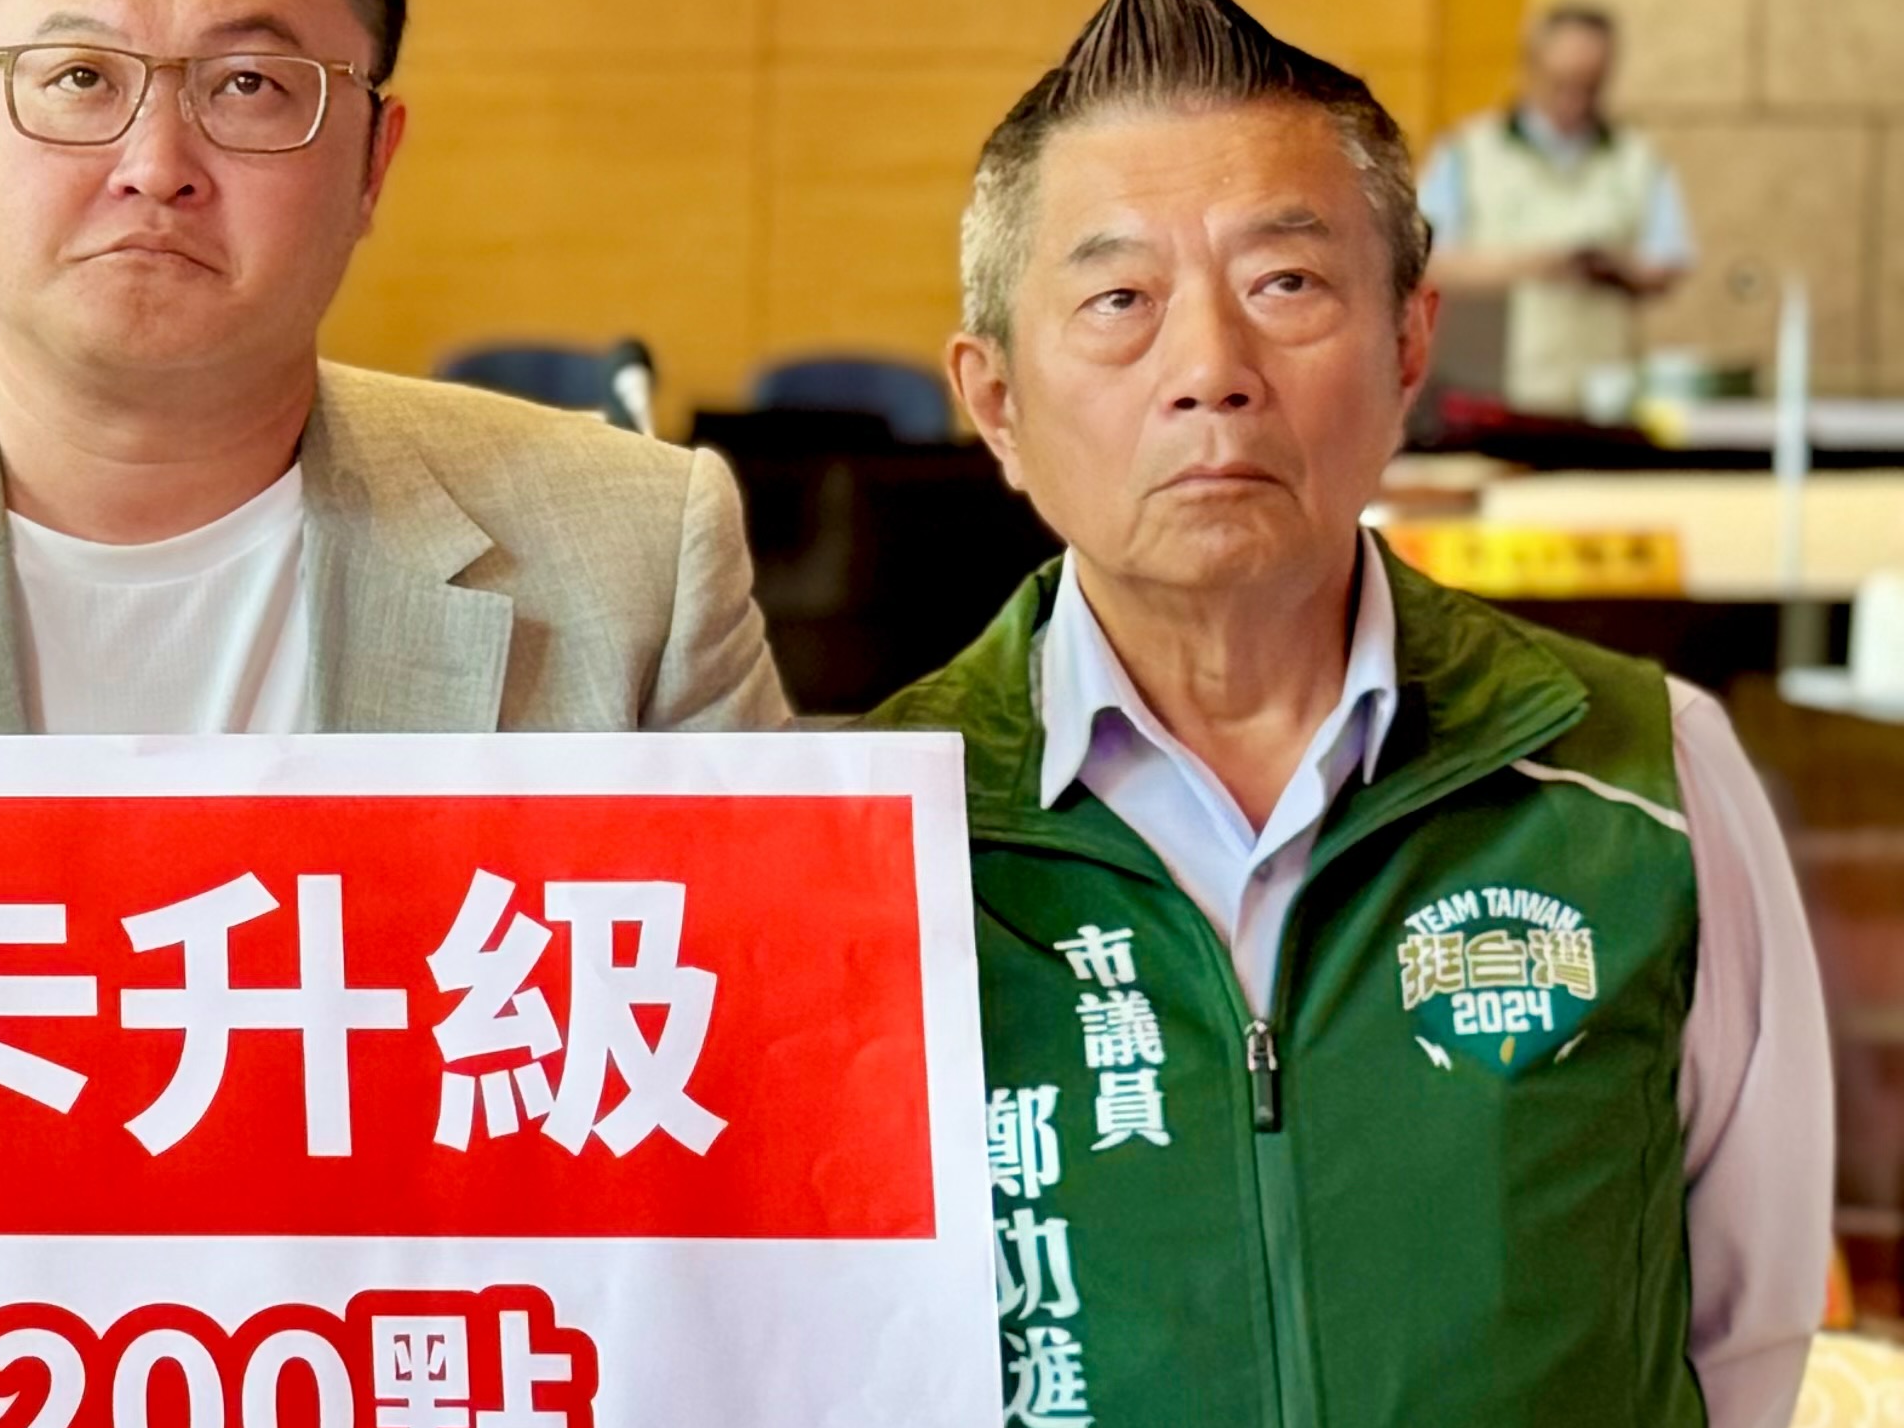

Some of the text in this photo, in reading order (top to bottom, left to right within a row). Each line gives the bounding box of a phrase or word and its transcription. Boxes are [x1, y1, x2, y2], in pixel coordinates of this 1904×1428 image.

[1404, 887, 1584, 934] TEAM TAIWAN
[1397, 928, 1597, 1011] 挺台灣
[1053, 924, 1171, 1152] 市議員
[1451, 989, 1554, 1036] 2024
